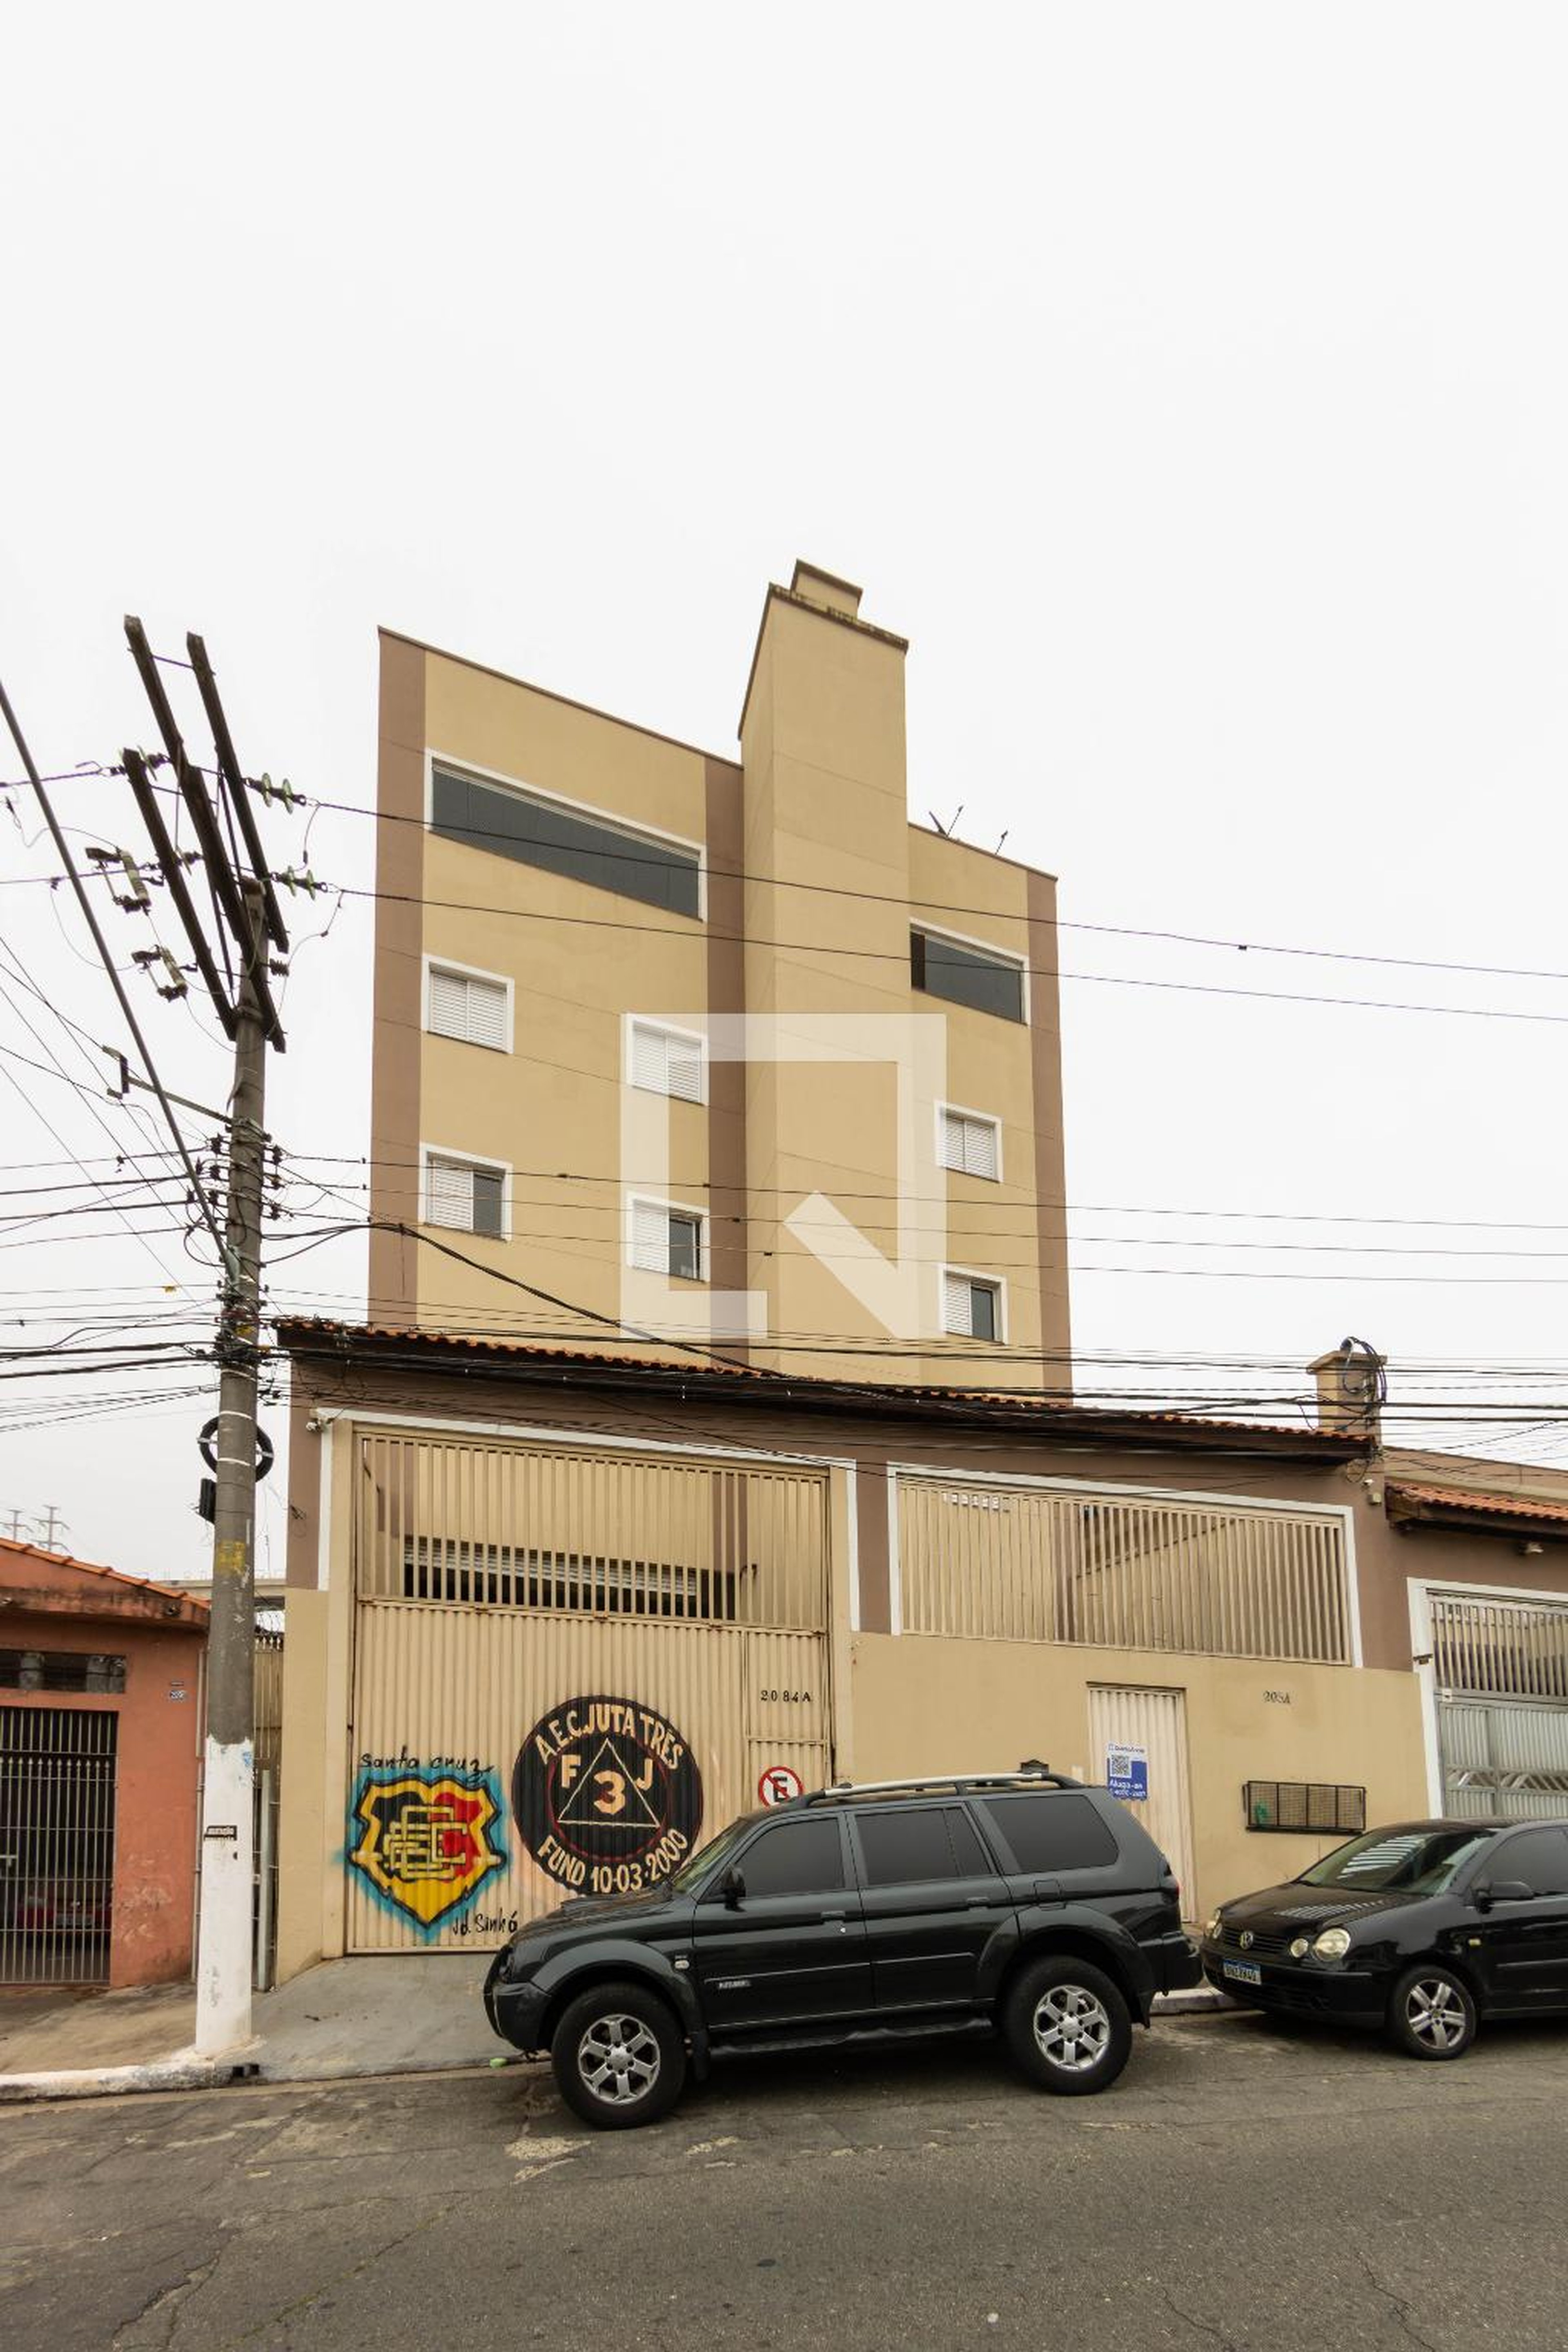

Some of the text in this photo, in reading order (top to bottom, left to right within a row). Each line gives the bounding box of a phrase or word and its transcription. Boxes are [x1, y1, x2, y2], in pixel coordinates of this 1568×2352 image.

[561, 1754, 653, 1815] F 3 J
[537, 1835, 586, 1886] FUND
